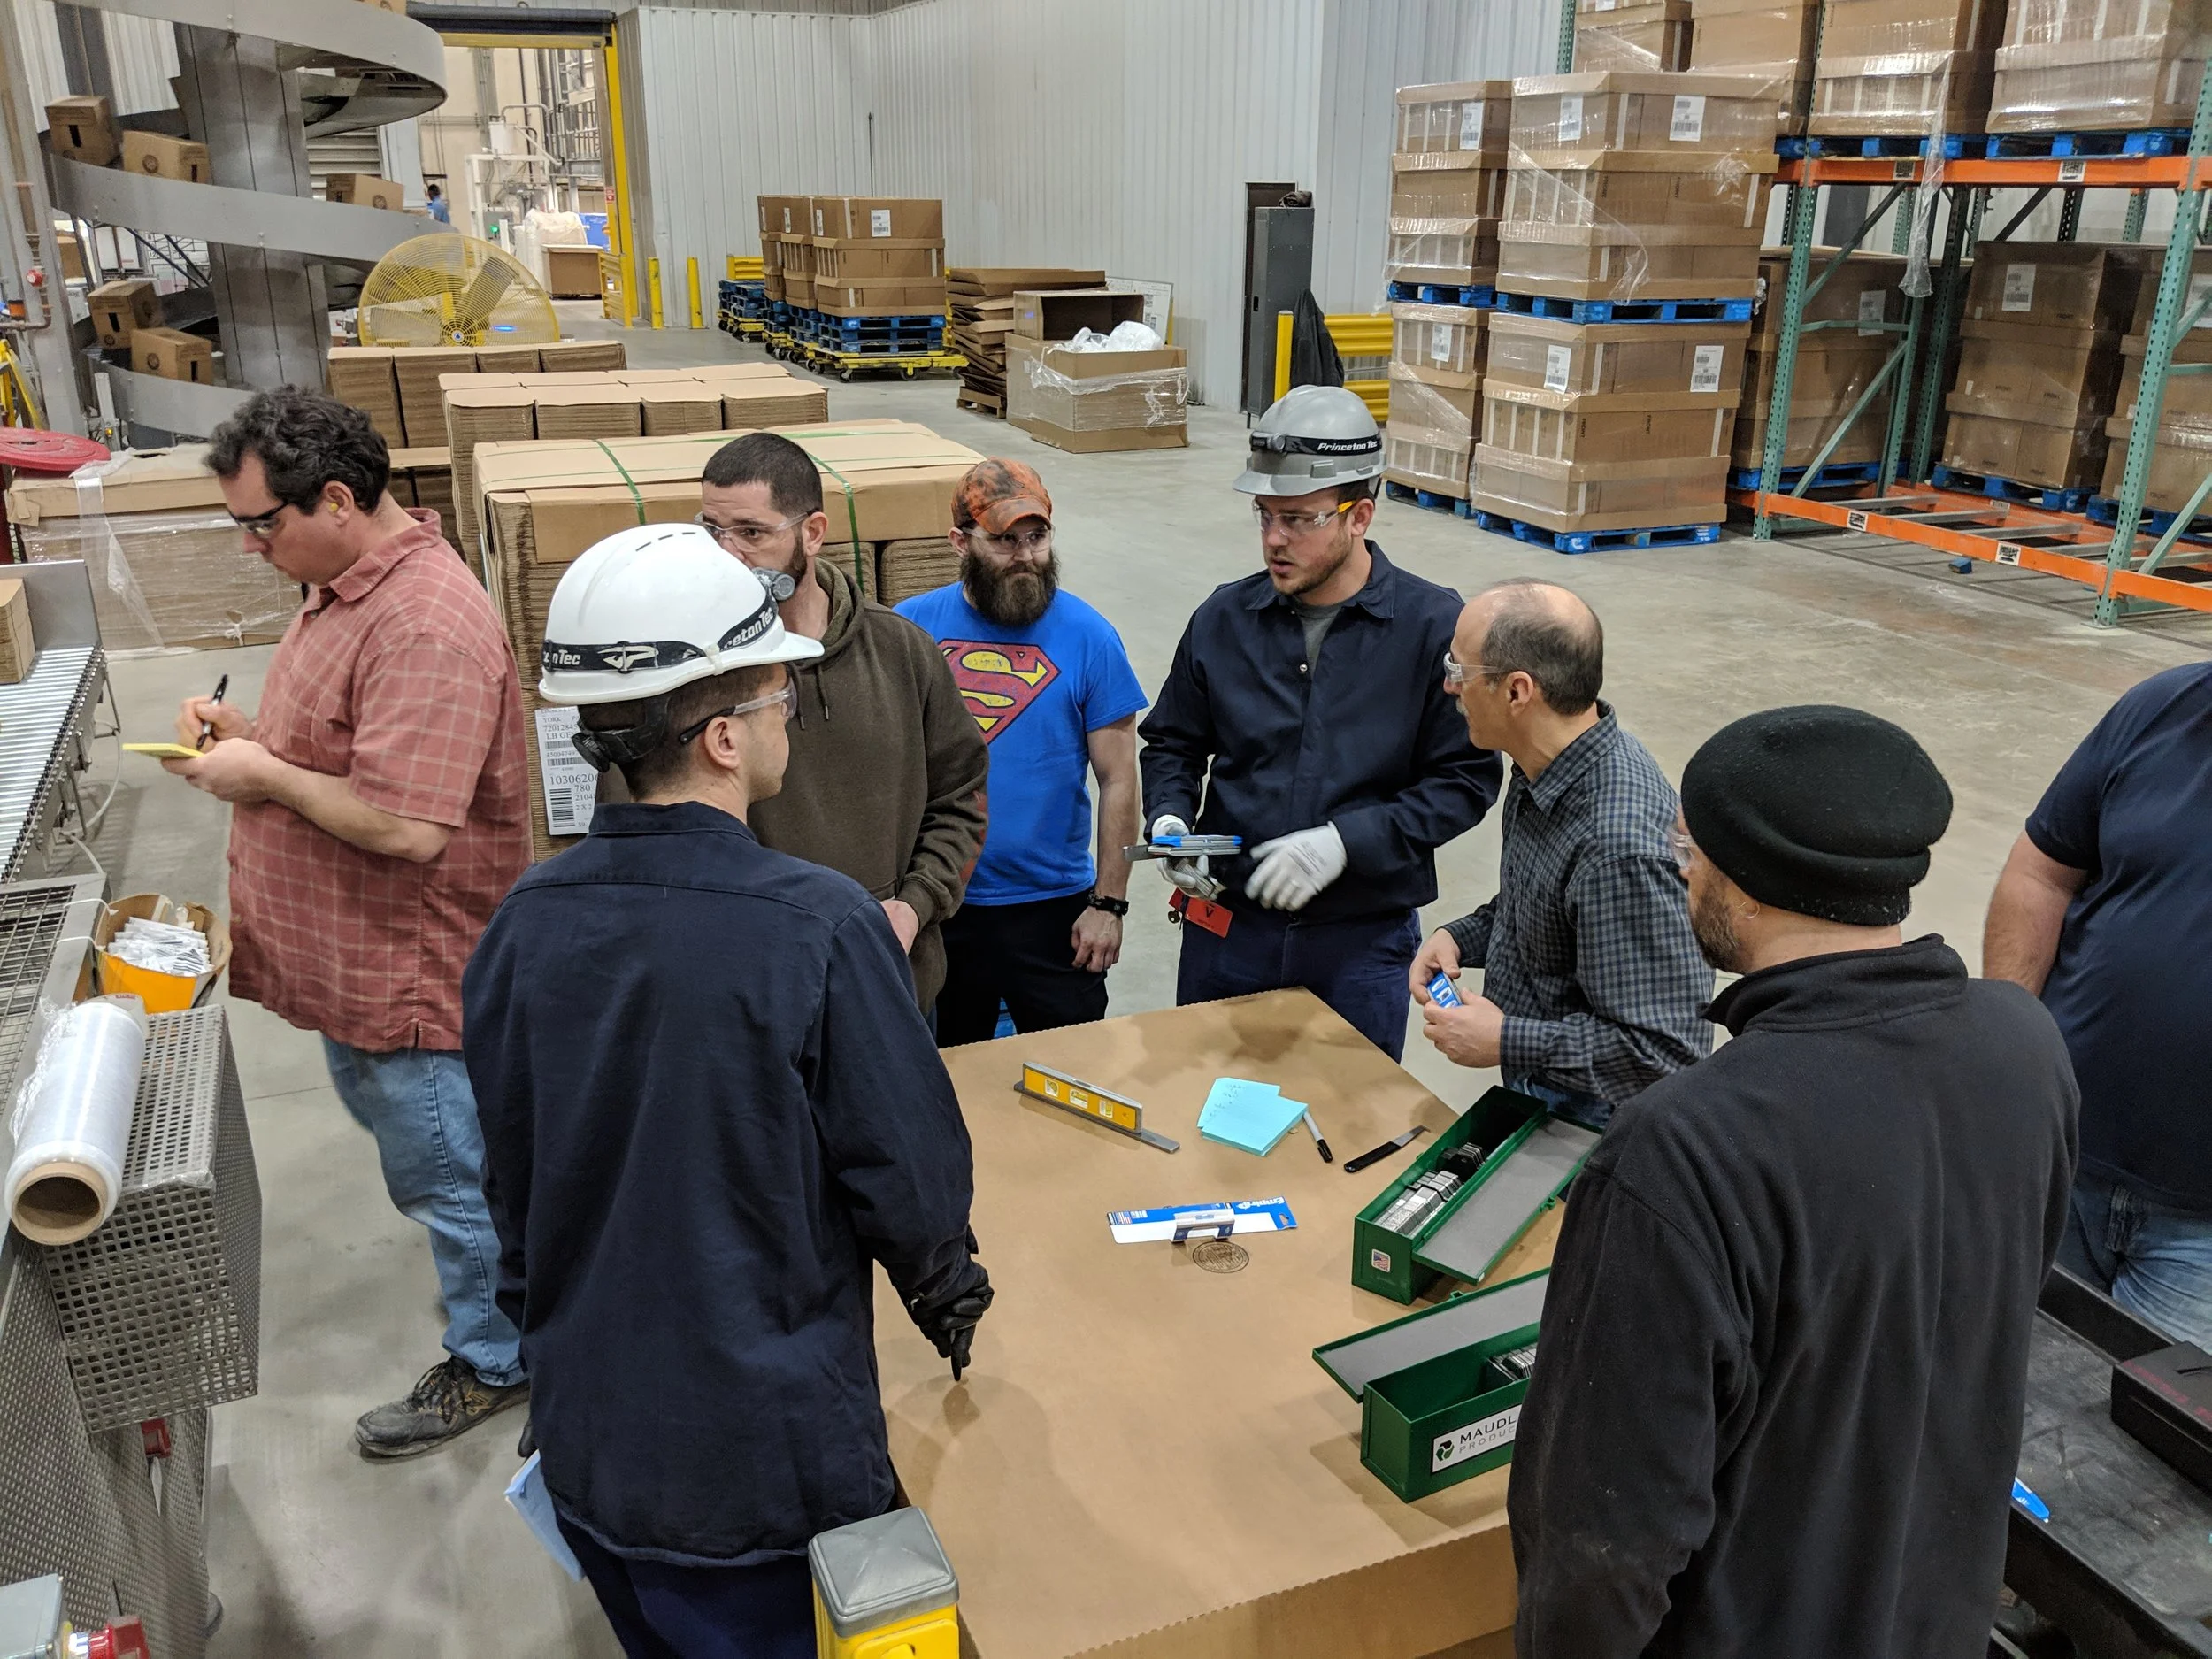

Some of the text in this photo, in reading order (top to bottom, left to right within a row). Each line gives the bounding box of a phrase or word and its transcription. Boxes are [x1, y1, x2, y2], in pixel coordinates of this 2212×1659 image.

[574, 784, 591, 793] 780
[1459, 1425, 1516, 1454] PRODUC
[1460, 1416, 1517, 1444] MAUDL
